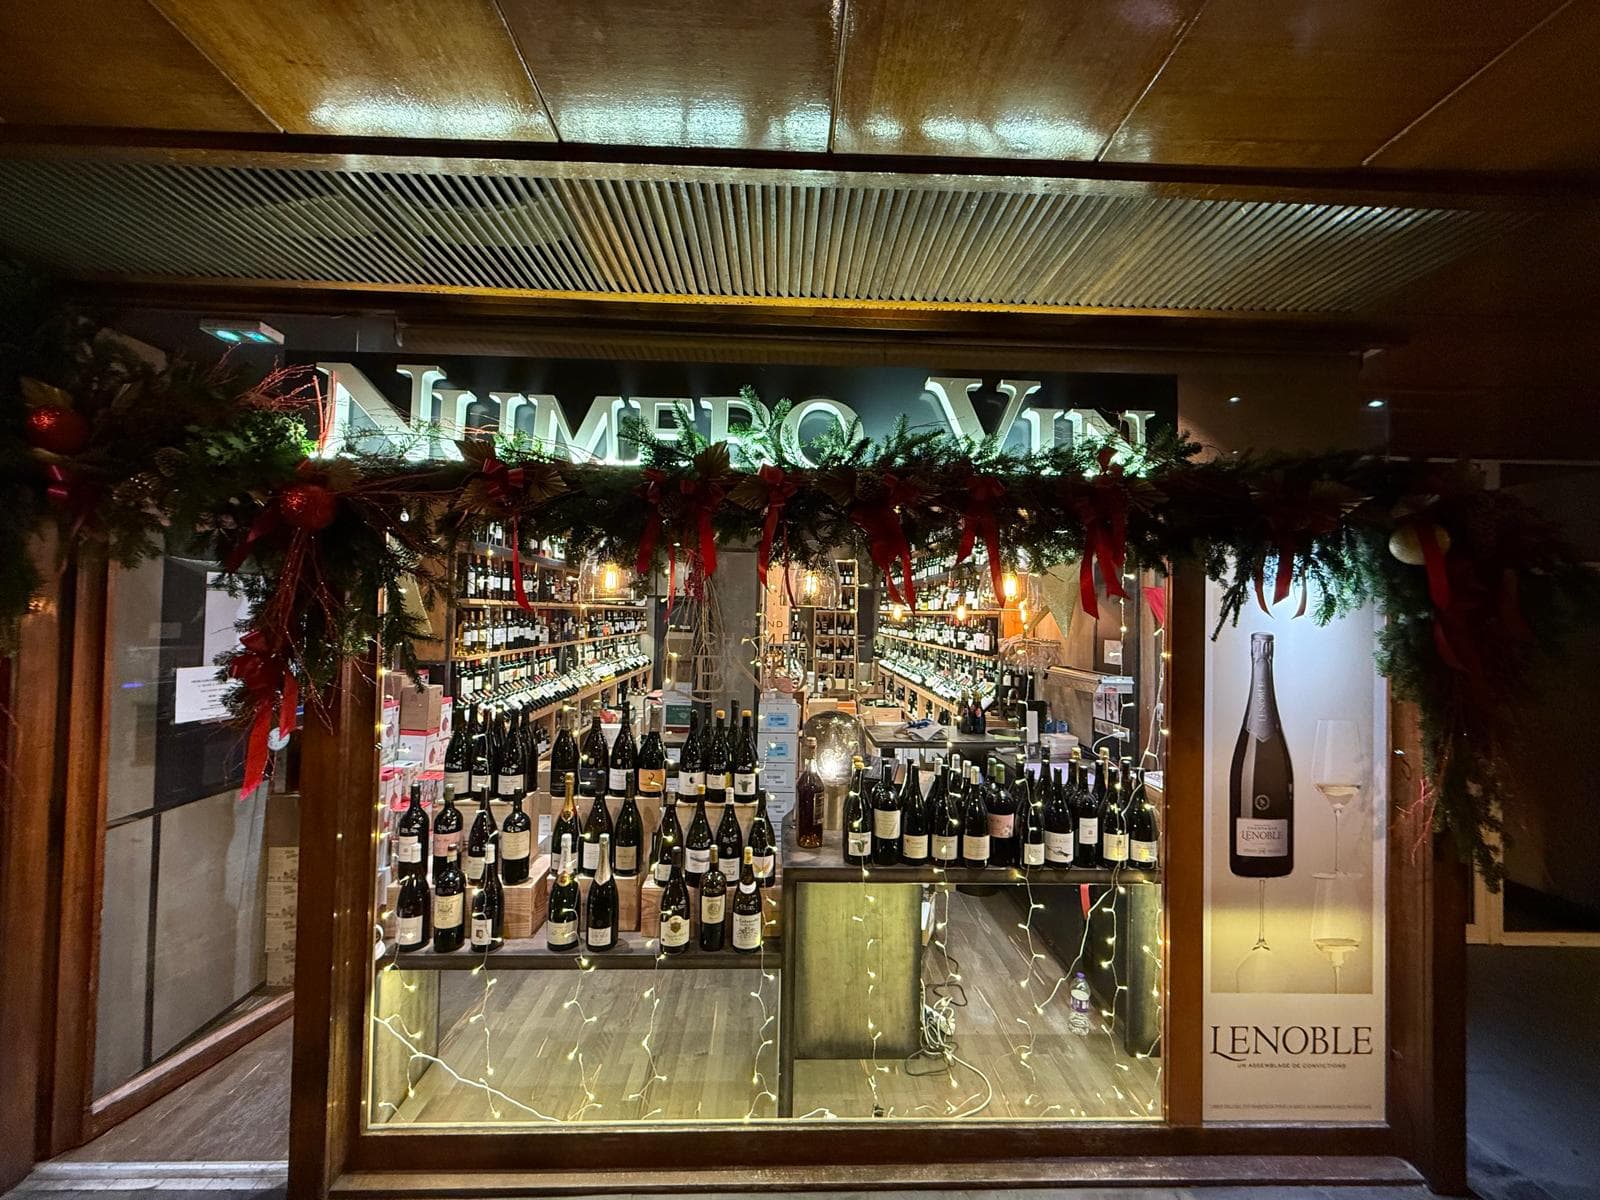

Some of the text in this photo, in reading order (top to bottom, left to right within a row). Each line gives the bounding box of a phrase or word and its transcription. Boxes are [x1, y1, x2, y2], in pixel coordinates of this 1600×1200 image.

[704, 632, 867, 649] CHMPAGNE
[1240, 830, 1283, 841] LENOBLE
[1209, 1026, 1374, 1061] LENOBLE
